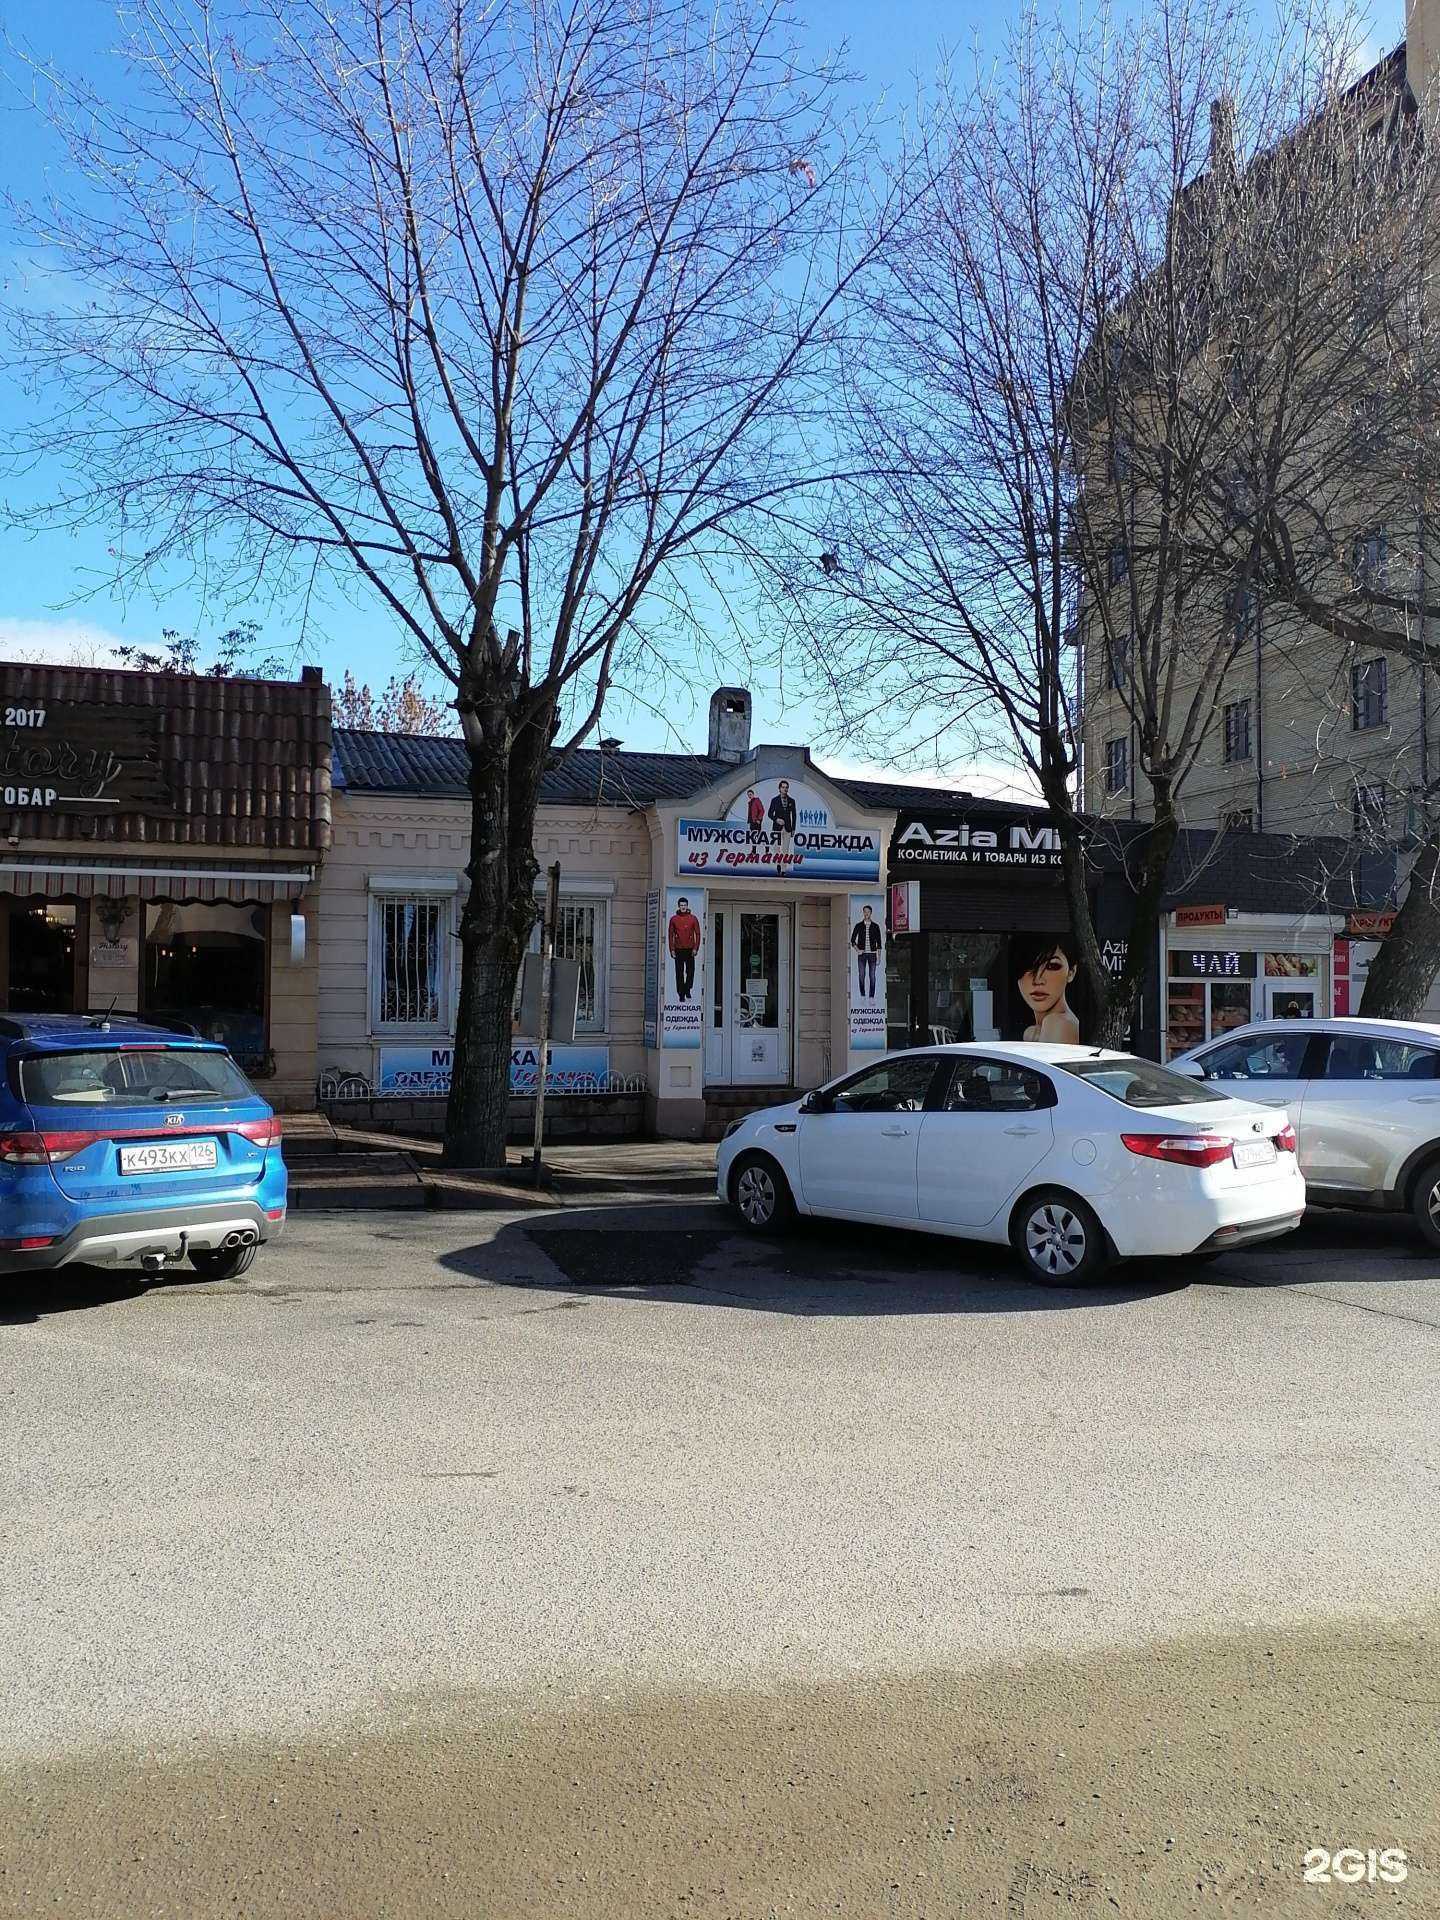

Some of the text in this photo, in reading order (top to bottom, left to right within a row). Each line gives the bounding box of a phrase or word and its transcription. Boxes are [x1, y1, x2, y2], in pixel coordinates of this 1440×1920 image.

[5, 707, 47, 728] 2017
[0, 786, 57, 806] ОБАР
[687, 827, 874, 852] МУЖСКАЯ ОДЕЖДА
[897, 822, 1062, 850] Azia Mi
[688, 848, 804, 867] из Германии
[898, 849, 967, 861] КОСМЕТИКА
[972, 852, 980, 862] И
[985, 852, 1027, 864] ТОВАРЫ
[1031, 854, 1046, 864] ИЗ
[1178, 910, 1223, 921] ПРОДУКТЫ
[1102, 955, 1126, 971] Mi
[1192, 952, 1240, 975] ЧАЙ
[664, 1004, 701, 1012] МУЖСКАЯ
[665, 1015, 699, 1023] ОДЕЖДА
[853, 1017, 884, 1025] ОДЕЖДА
[166, 1115, 184, 1126] KIA
